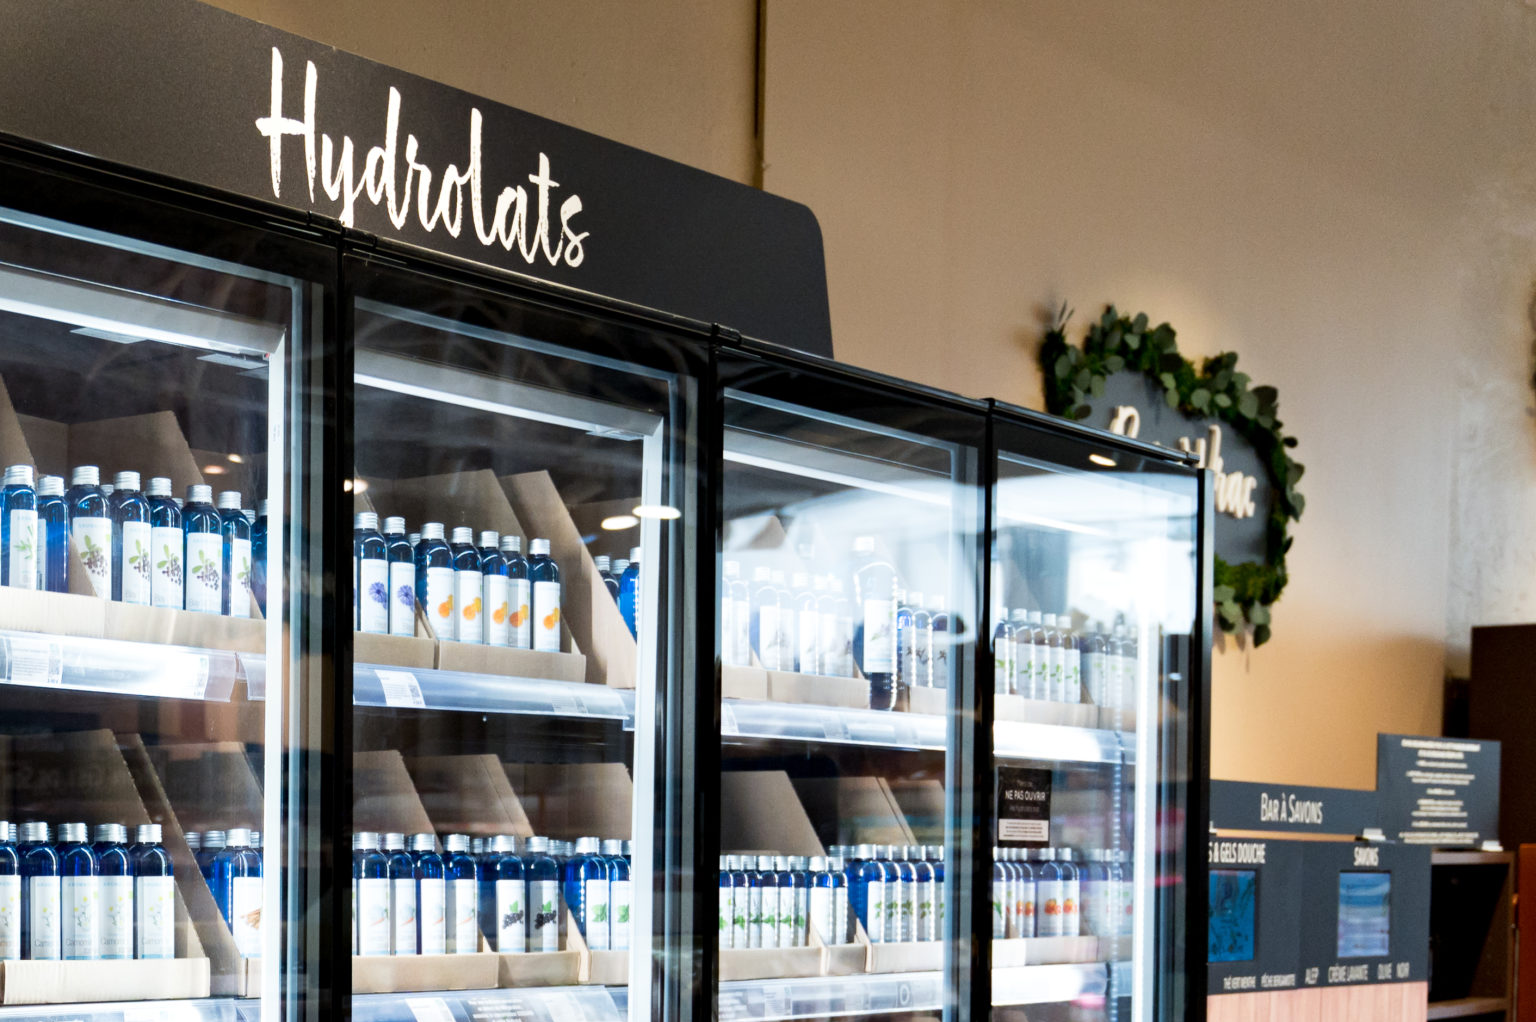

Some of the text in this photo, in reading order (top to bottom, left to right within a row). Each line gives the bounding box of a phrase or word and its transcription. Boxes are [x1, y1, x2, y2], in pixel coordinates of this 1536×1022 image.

[255, 47, 590, 268] Hydrolats
[1005, 789, 1046, 801] NE PAS OUVRIR
[1220, 843, 1237, 863] GELS
[1237, 843, 1266, 864] DOUCHE
[1353, 846, 1379, 866] SAVONS
[1304, 966, 1319, 985] ALEP
[1377, 963, 1392, 980] OLIVE
[1396, 962, 1410, 978] NOIR
